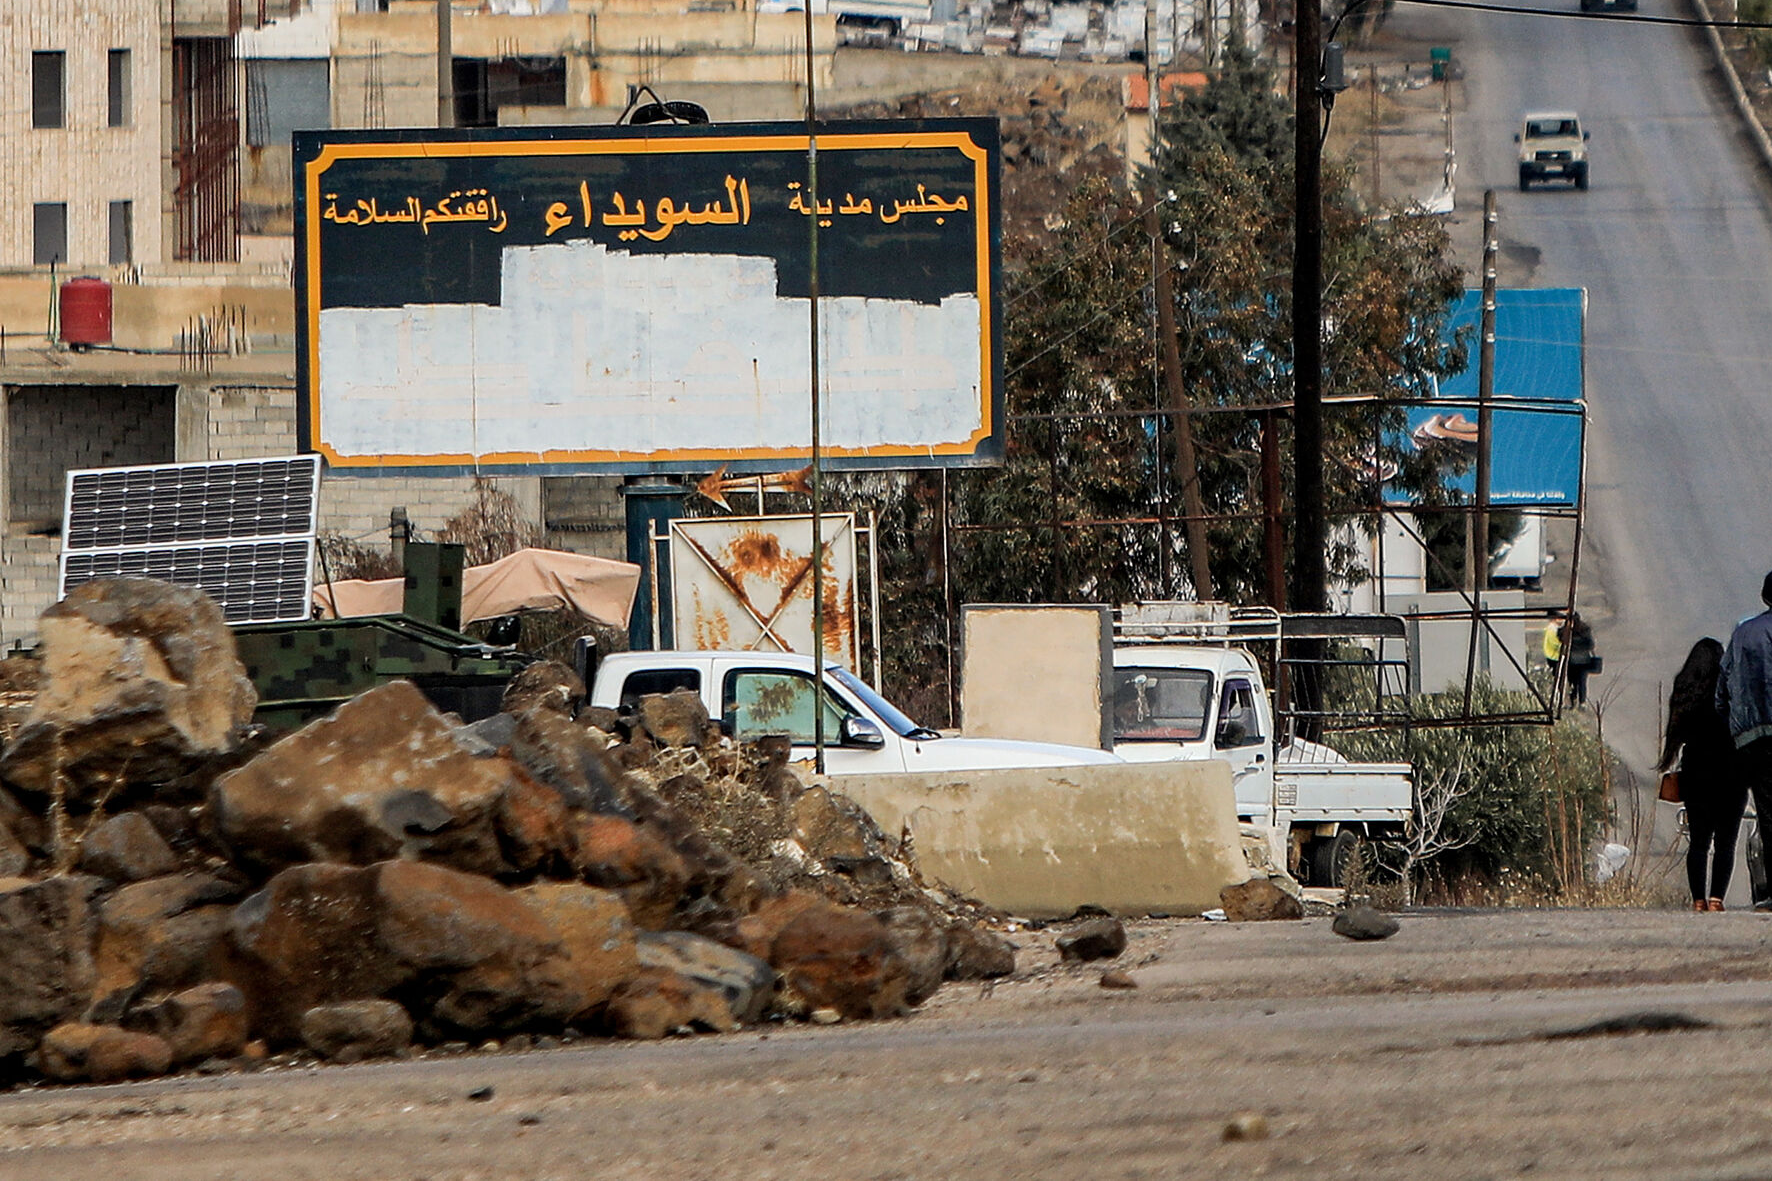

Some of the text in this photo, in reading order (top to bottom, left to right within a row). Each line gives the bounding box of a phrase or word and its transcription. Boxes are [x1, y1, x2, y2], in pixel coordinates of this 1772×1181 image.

[322, 174, 969, 241] مجلس مدينة السويداء رافقتكم السلامة
